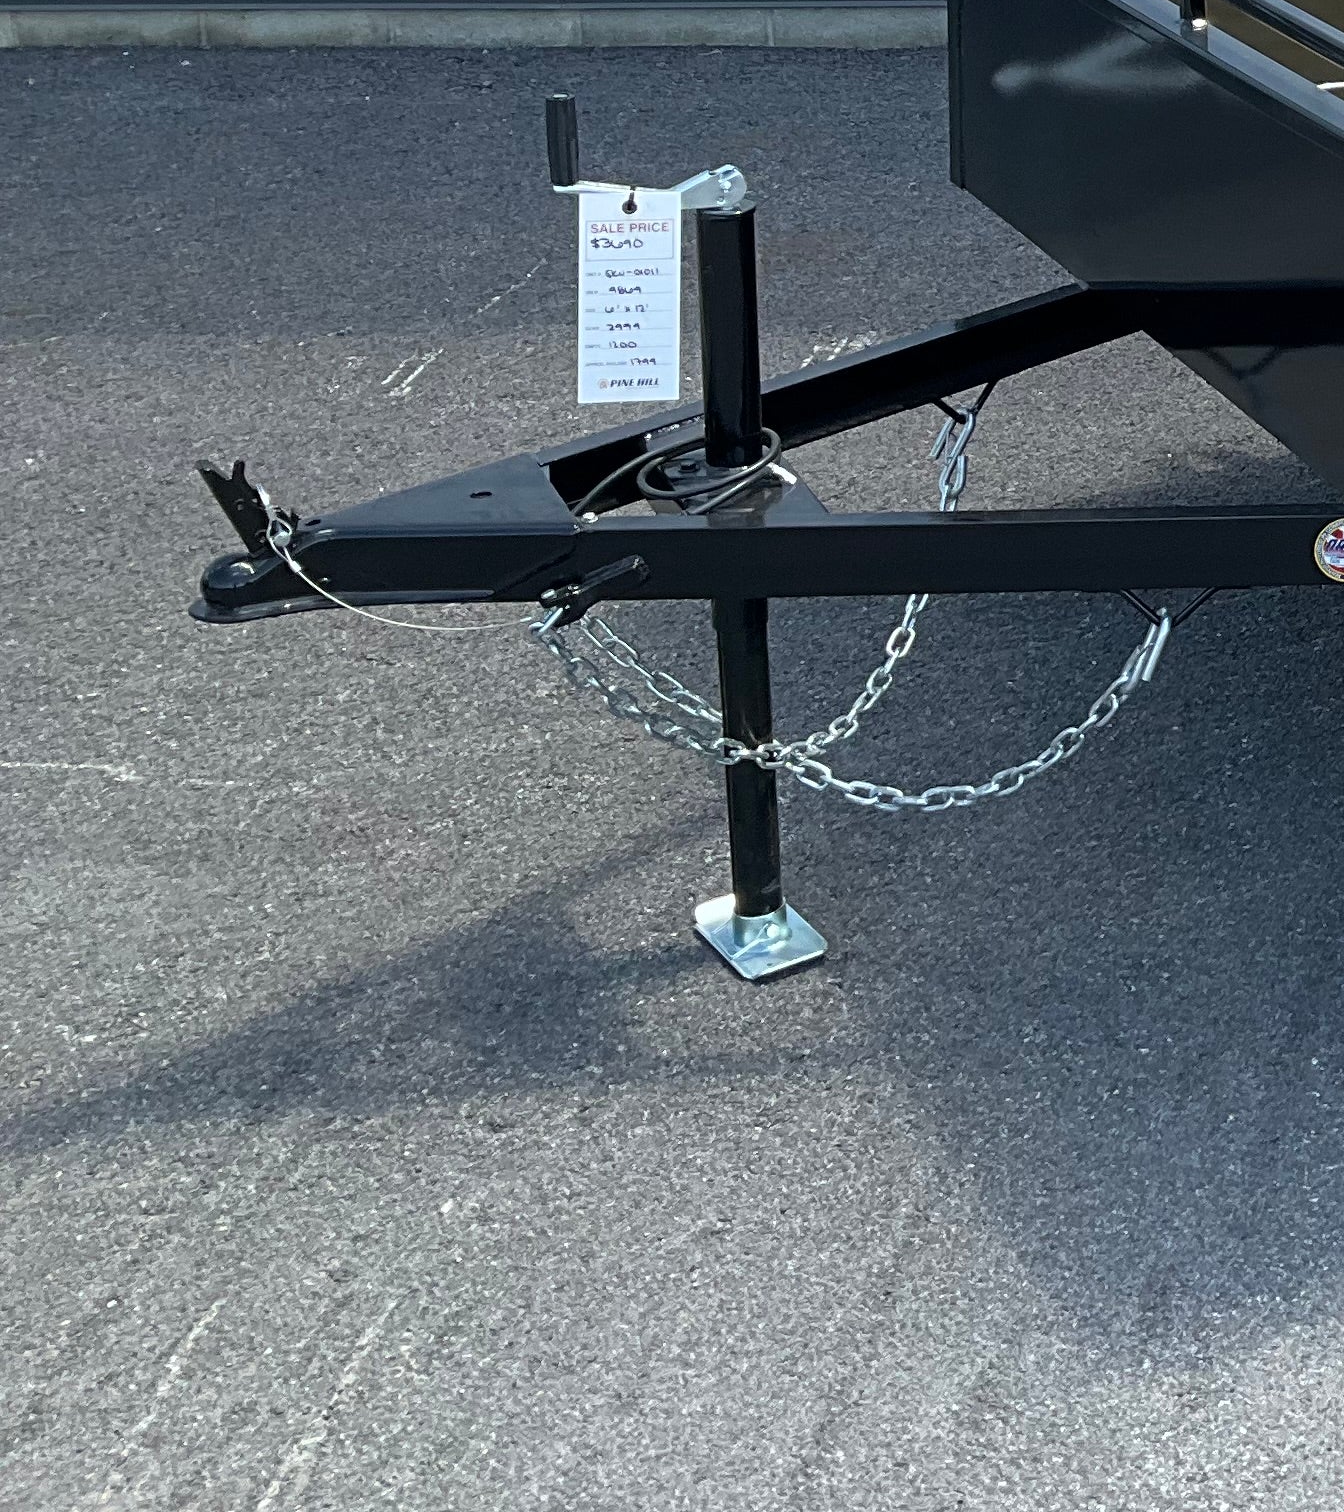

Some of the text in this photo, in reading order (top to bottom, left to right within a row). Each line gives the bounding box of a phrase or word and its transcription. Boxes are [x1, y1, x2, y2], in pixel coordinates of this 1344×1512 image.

[590, 221, 670, 234] SALE PRICE
[608, 340, 638, 349] 1200
[610, 377, 660, 388] PINE HILL
